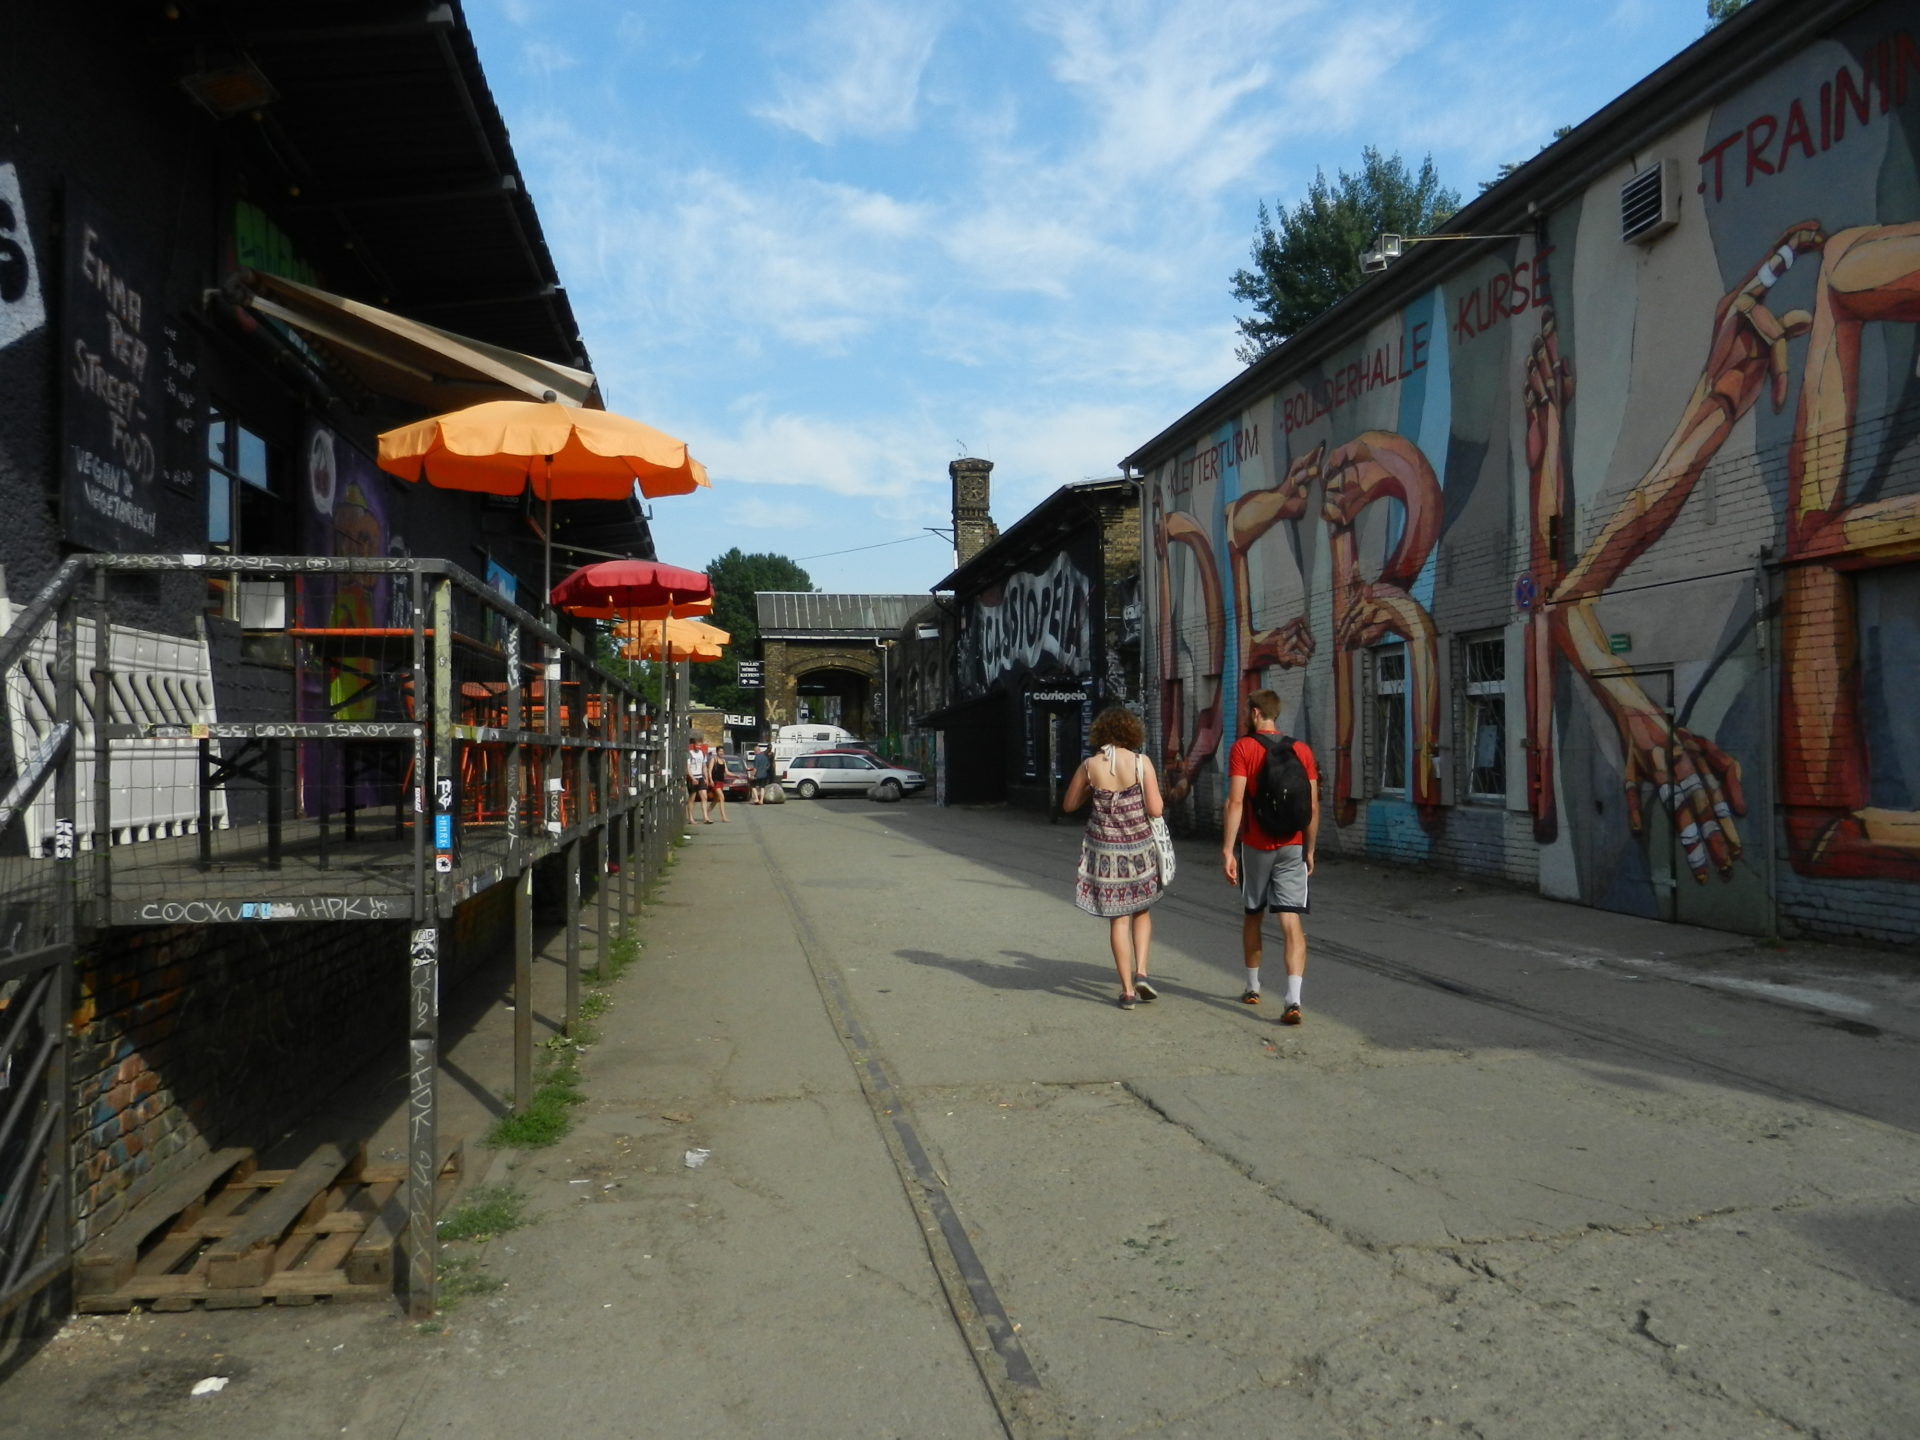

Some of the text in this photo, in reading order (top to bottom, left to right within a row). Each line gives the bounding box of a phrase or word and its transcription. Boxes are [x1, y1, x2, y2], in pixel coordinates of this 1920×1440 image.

[1458, 247, 1556, 345] KURSE
[1284, 322, 1427, 434] BOULDERHALLE
[75, 444, 120, 493] VEGAN
[109, 411, 155, 483] FOOD
[1170, 423, 1258, 498] KLETTERTURM
[985, 569, 1083, 667] CASSIOPEIA
[1033, 690, 1087, 702] cassiopeia
